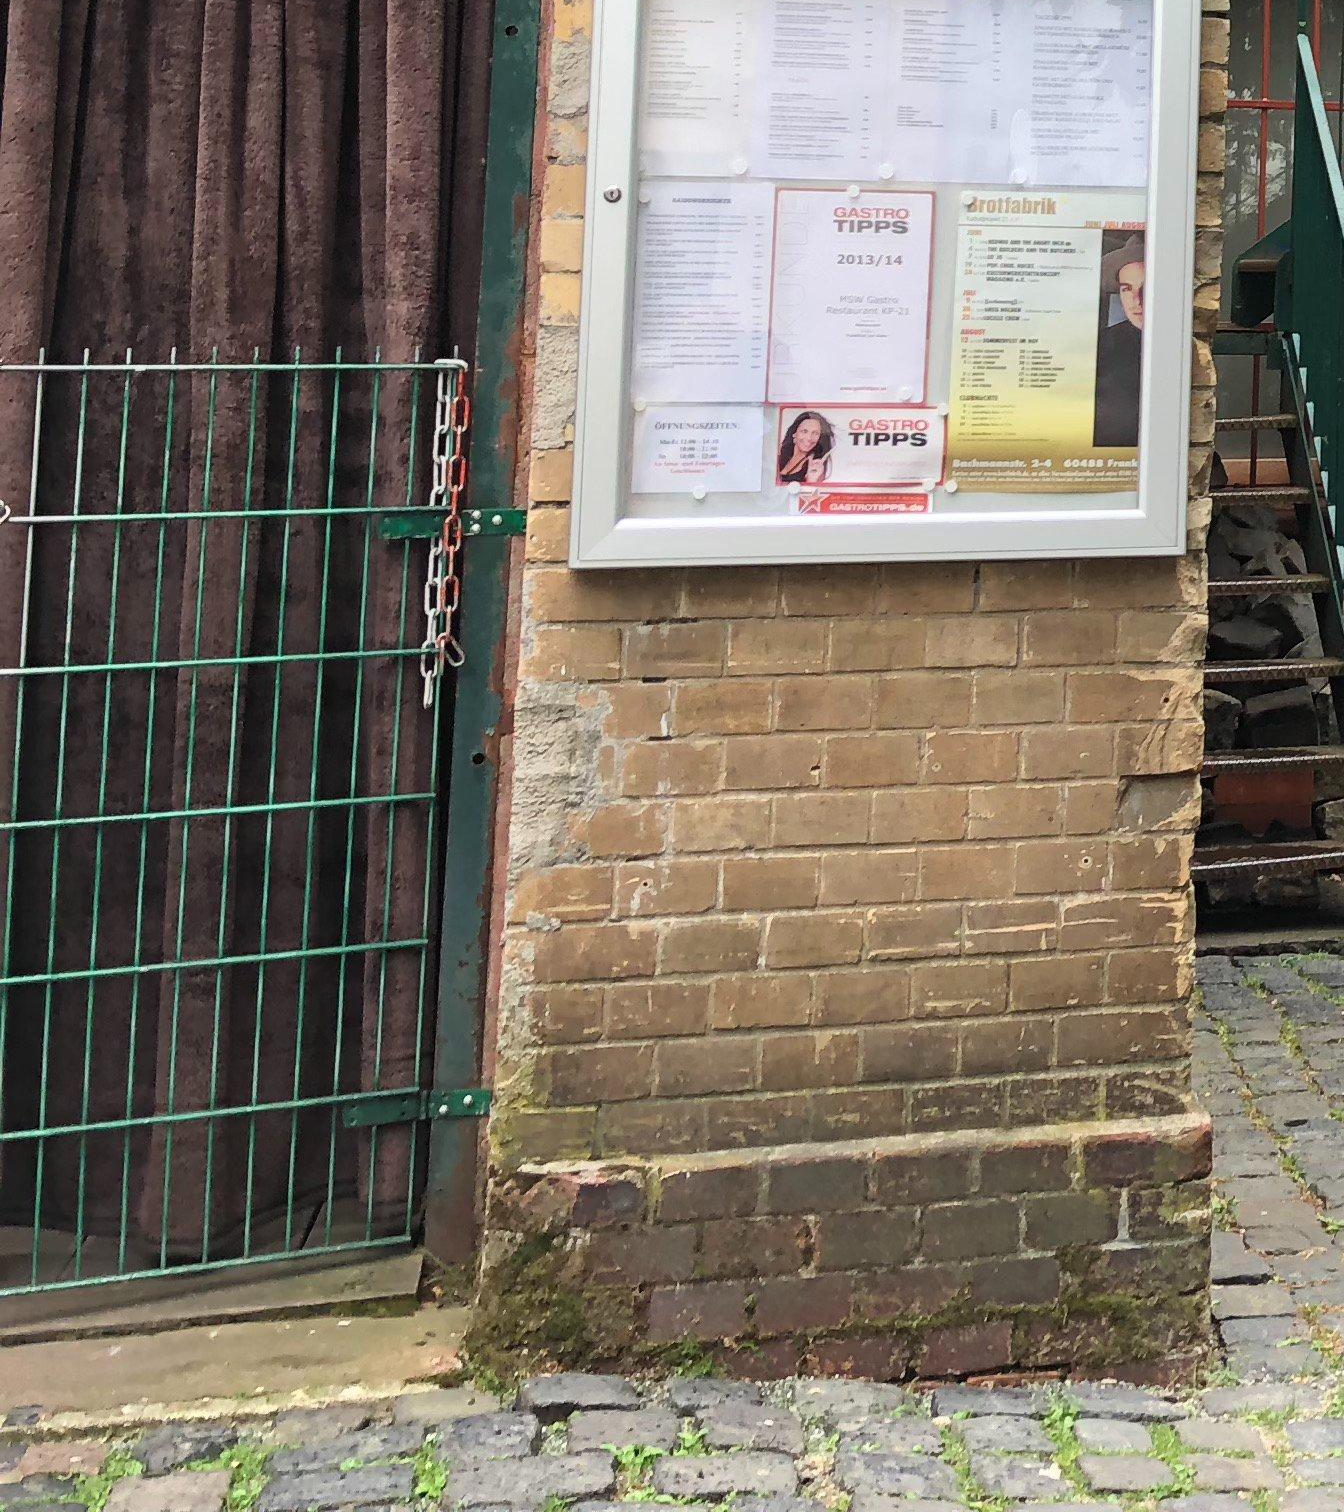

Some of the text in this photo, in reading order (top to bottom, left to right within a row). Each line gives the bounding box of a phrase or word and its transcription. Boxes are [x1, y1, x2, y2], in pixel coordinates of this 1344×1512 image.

[833, 206, 910, 219] GASTRO
[832, 219, 910, 234] TIPPS
[836, 254, 903, 267] 2013/14
[849, 419, 929, 431] GASTRO
[848, 432, 928, 447] TIPPS
[1031, 459, 1052, 468] 2-4
